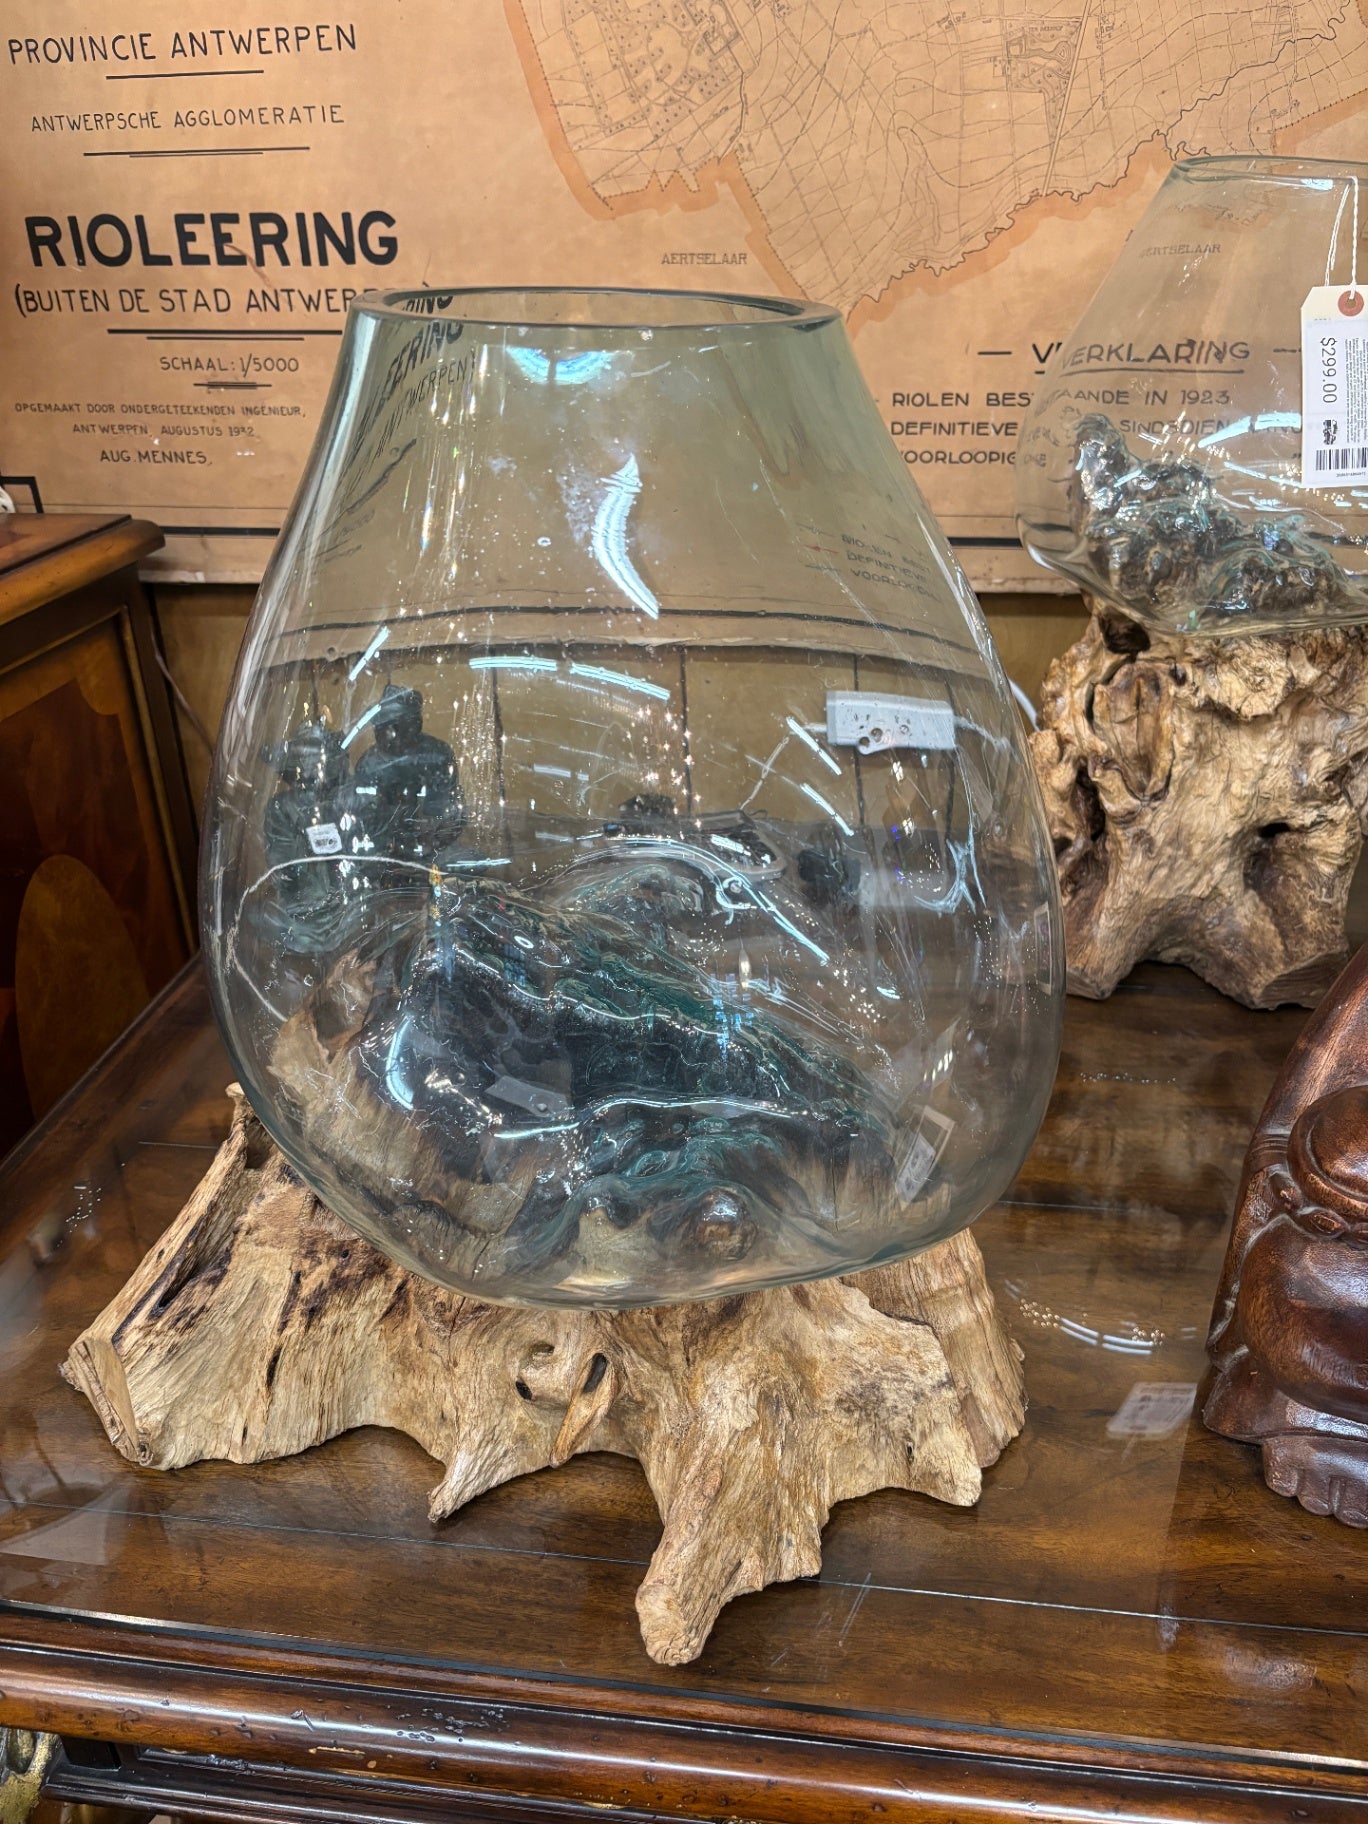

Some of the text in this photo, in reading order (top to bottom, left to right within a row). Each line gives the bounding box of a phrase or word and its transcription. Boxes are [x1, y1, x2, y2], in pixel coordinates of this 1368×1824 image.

[8, 24, 357, 65] PROVINCIE ANTWERPEN
[31, 105, 345, 132] ANTWERPSCHE AGGLOMERATIE
[24, 211, 399, 268] RIOLEERING
[661, 252, 747, 265] AERTSELAAR
[119, 288, 149, 313] DE
[159, 288, 231, 313] STAD
[160, 353, 299, 377] SCHAAL: 1/5000
[1320, 337, 1338, 404] $299.00
[15, 403, 81, 414] OPGEMAAKT
[87, 403, 116, 414] DOOR
[892, 392, 970, 408] RIOLEN
[1146, 390, 1168, 405] IN
[1180, 389, 1230, 405] 1923
[160, 425, 223, 437] AUGUSTUS
[891, 421, 1018, 437] DEFINITIEVE
